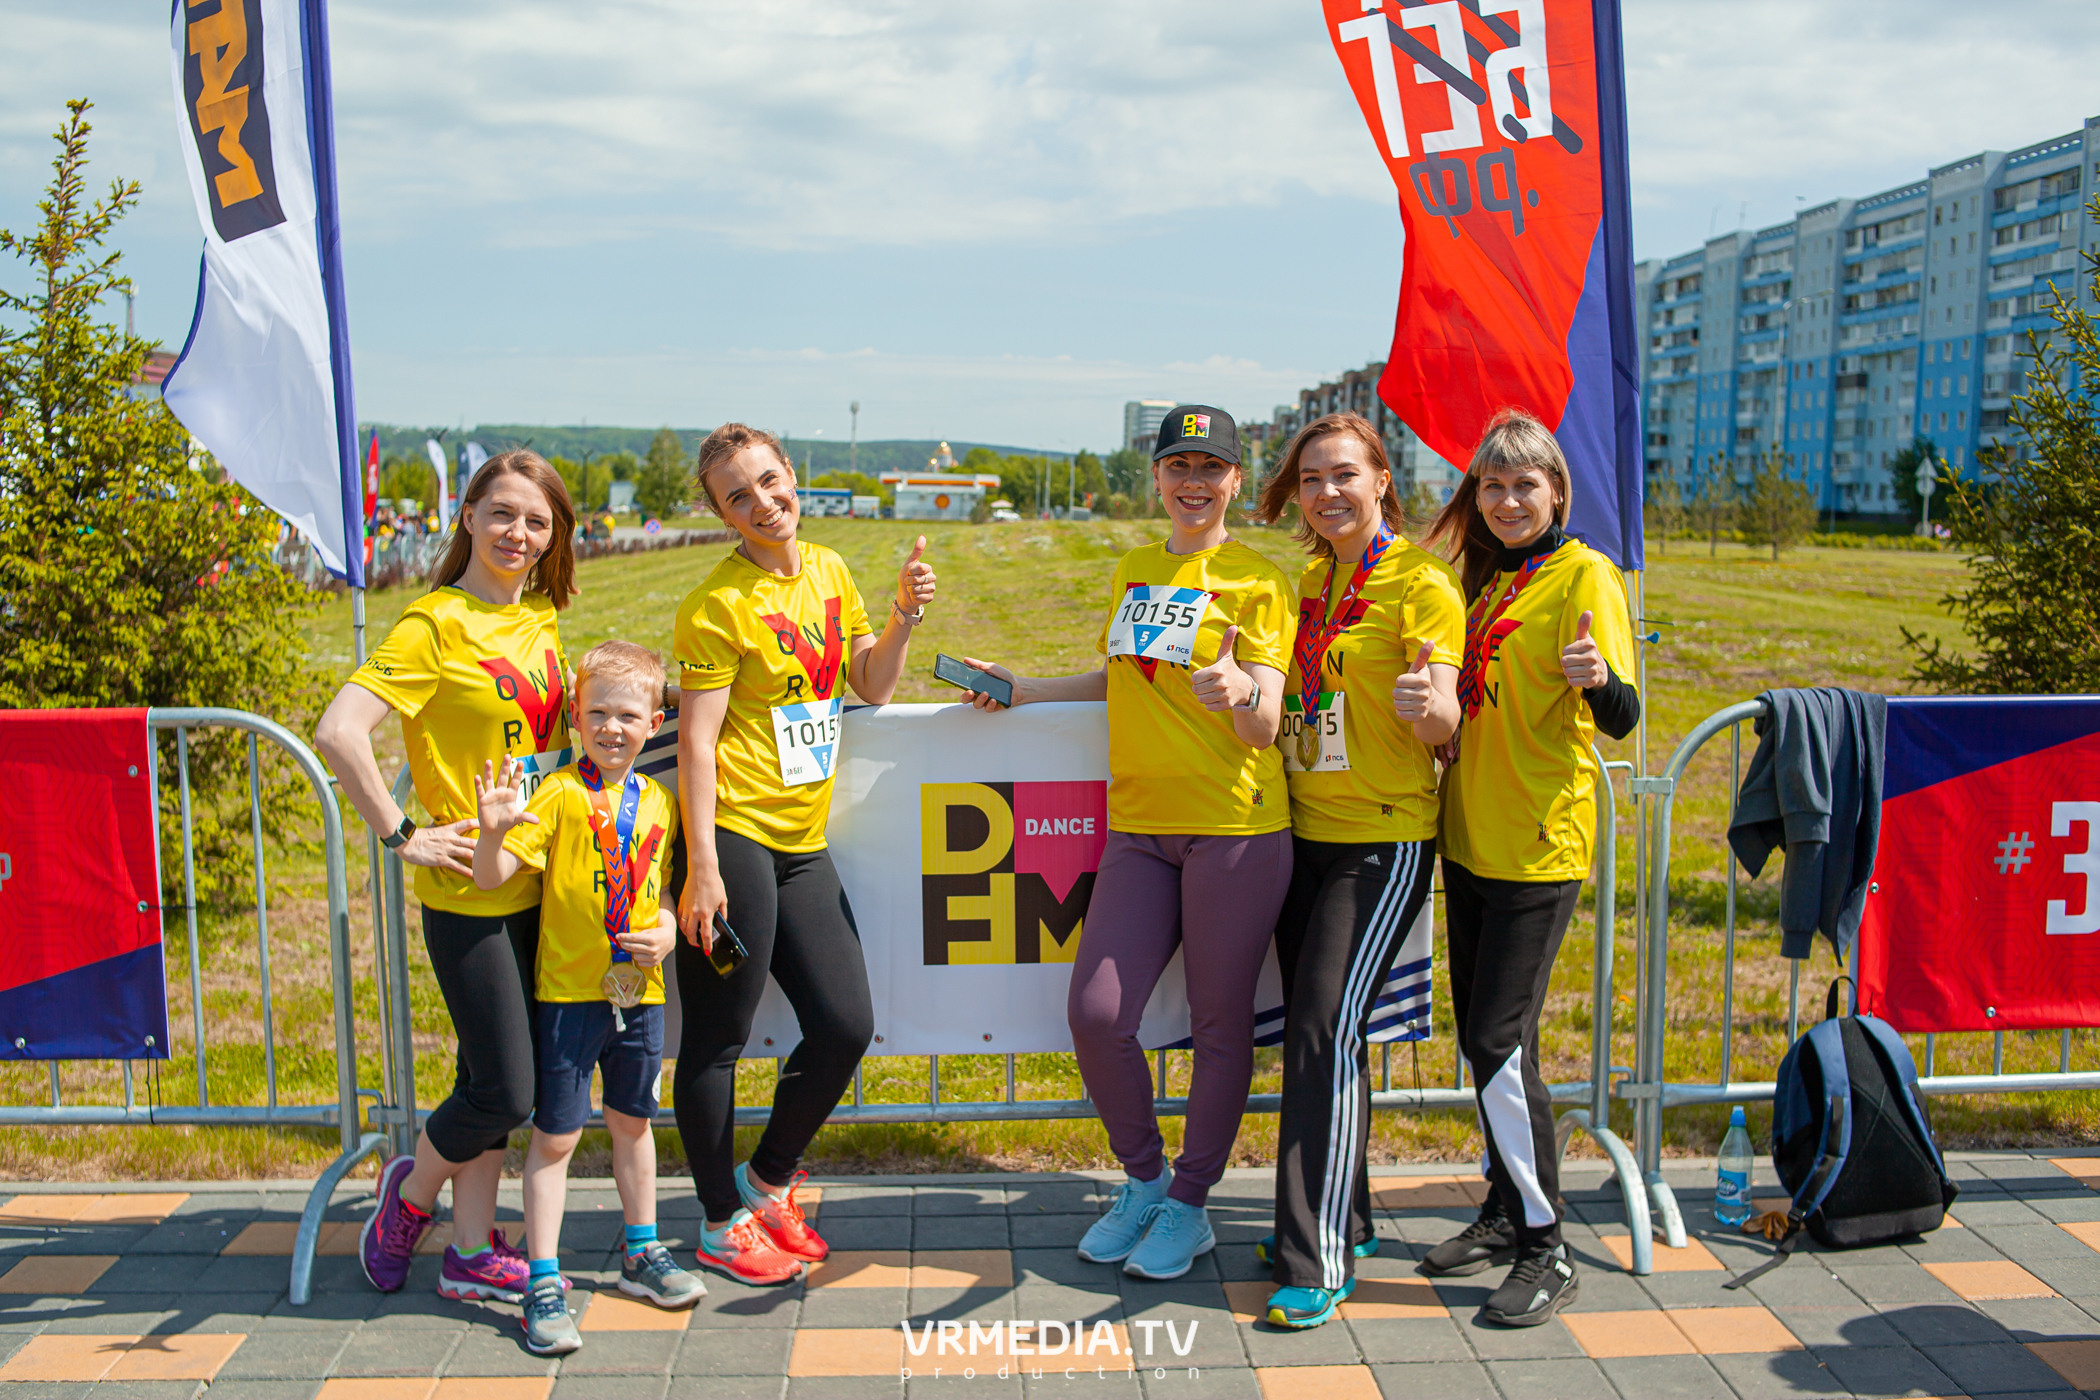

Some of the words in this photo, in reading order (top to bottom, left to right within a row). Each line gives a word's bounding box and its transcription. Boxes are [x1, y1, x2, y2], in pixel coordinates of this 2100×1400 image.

[1121, 601, 1197, 628] 10155
[776, 616, 846, 656] ONE
[1139, 631, 1150, 642] 5
[495, 664, 565, 701] ONE
[822, 752, 828, 765] 5
[1025, 818, 1095, 836] DANCE
